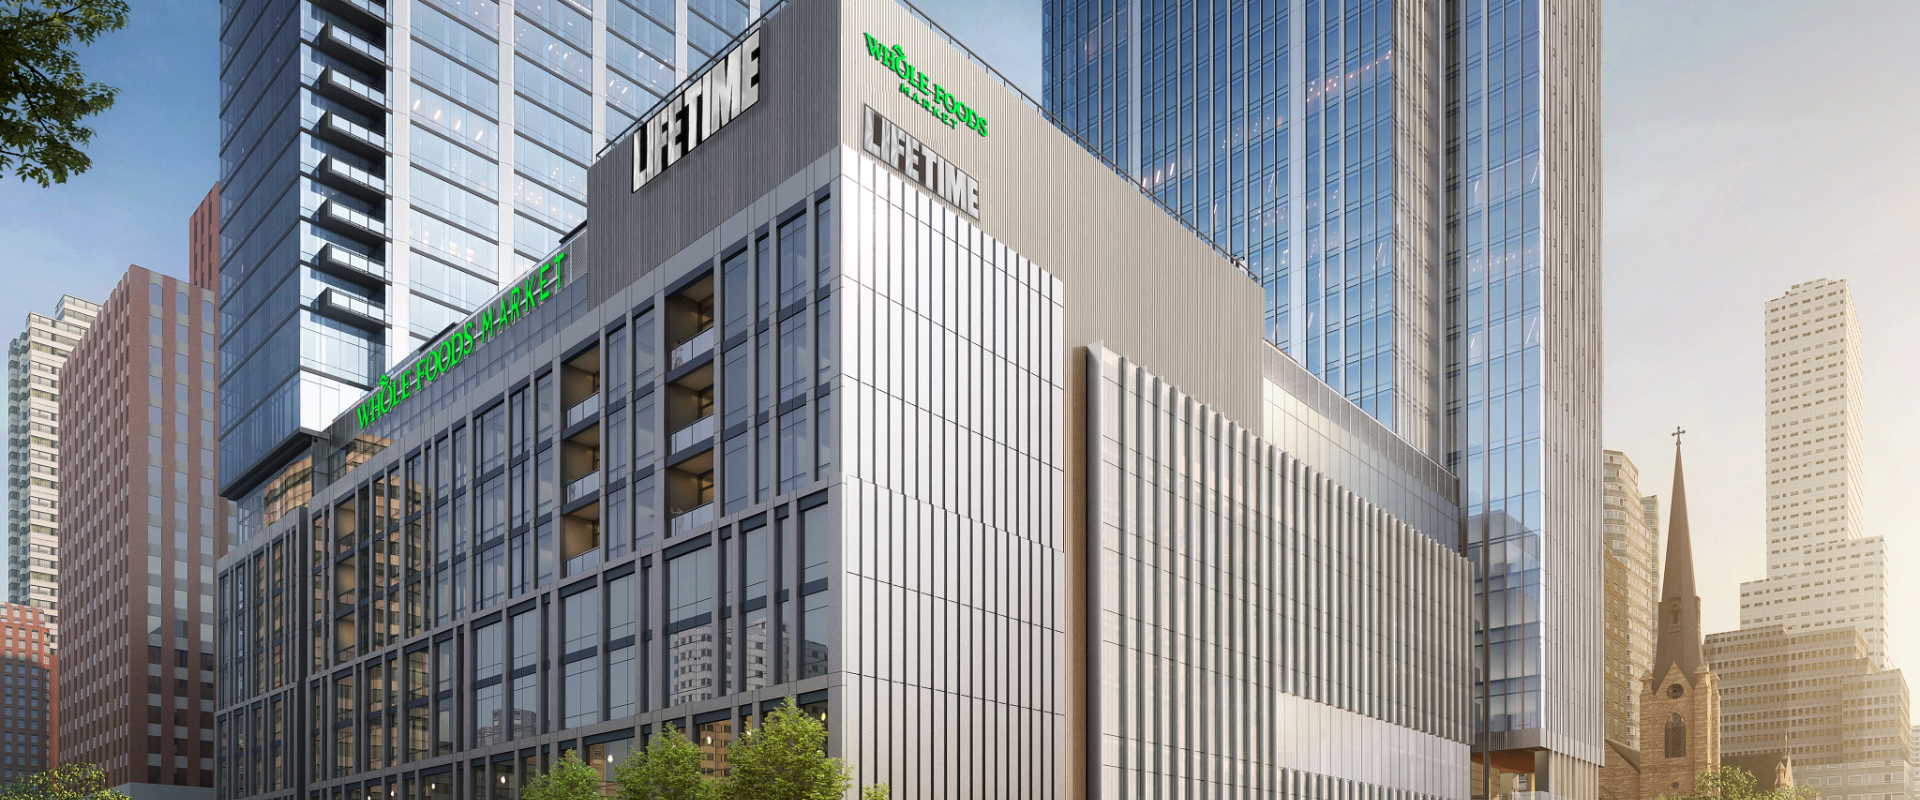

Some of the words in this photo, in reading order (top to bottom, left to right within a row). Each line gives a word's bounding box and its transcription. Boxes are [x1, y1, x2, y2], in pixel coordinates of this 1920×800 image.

[864, 32, 930, 95] WHOLE
[934, 83, 988, 137] FOODS
[900, 83, 958, 129] MARKET
[356, 370, 411, 430] WHOLE
[416, 321, 474, 391] FOODS
[481, 252, 565, 343] MARKET
